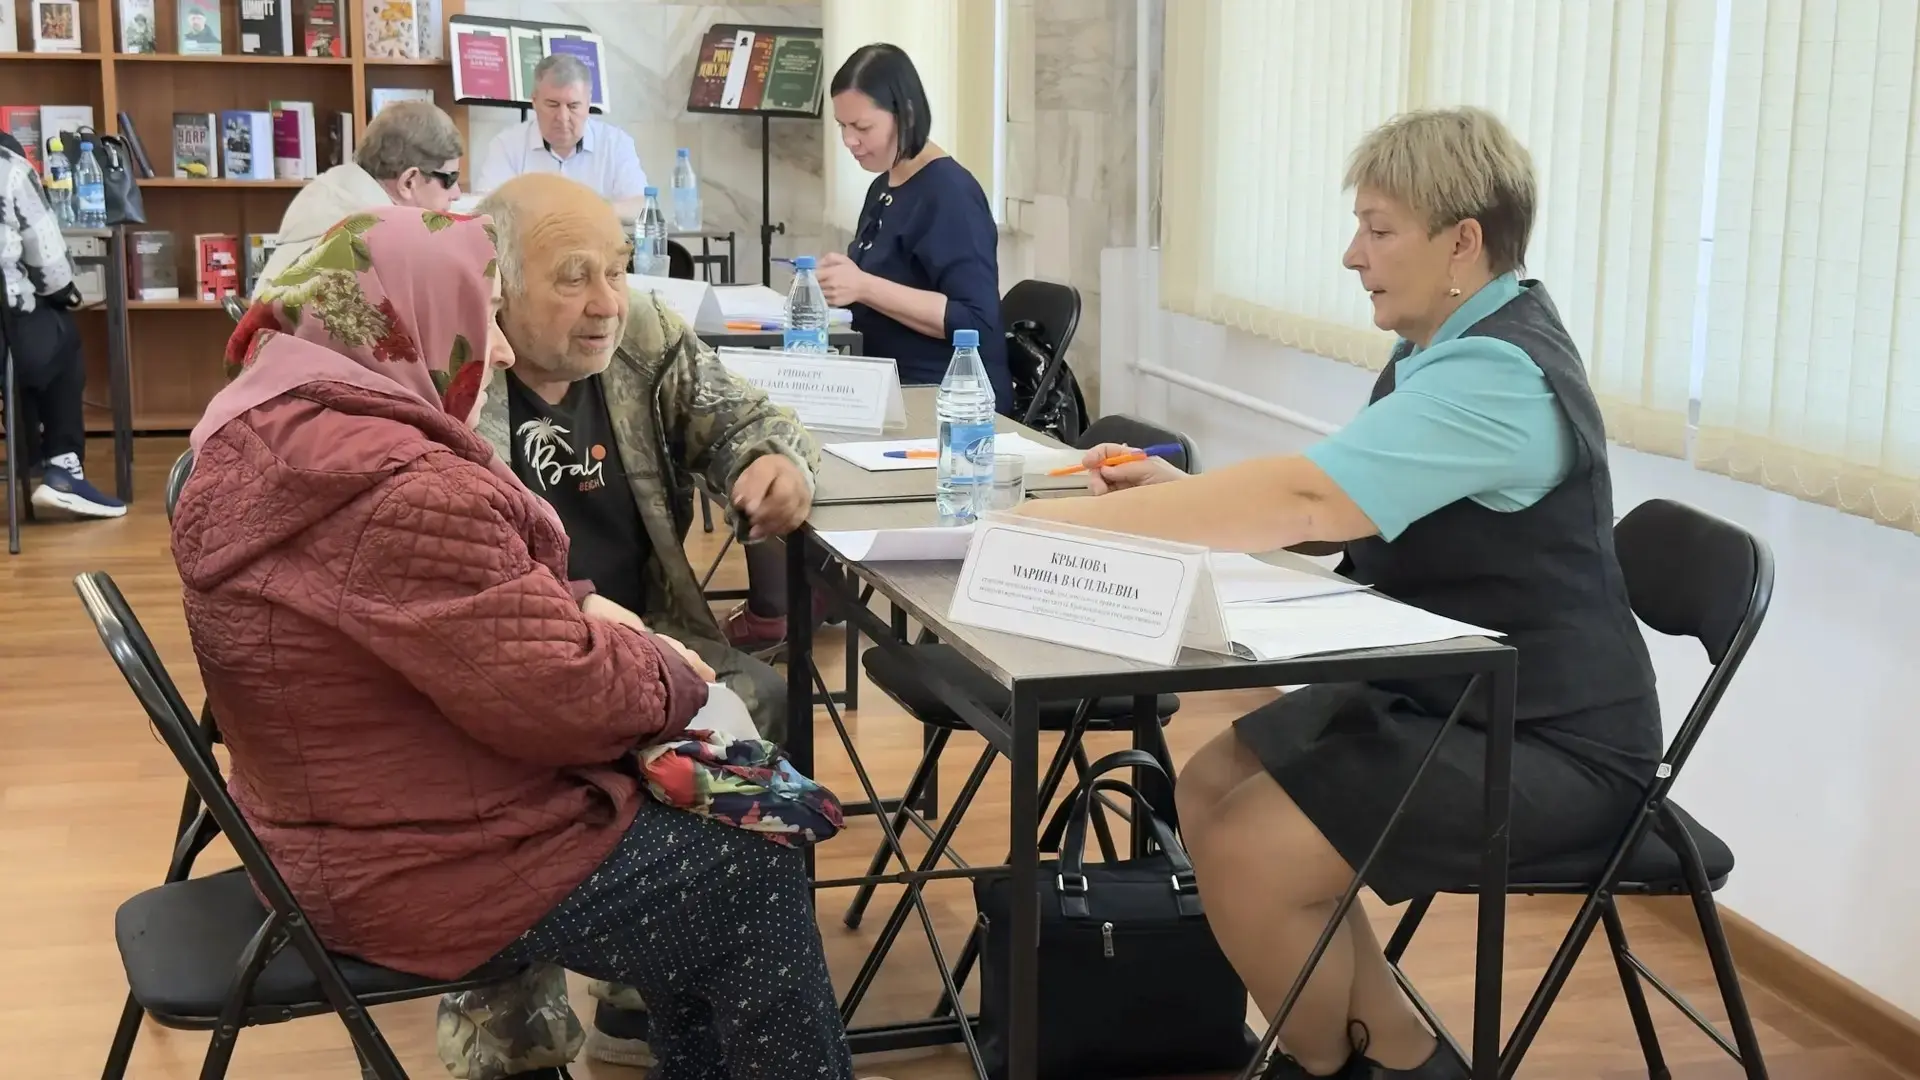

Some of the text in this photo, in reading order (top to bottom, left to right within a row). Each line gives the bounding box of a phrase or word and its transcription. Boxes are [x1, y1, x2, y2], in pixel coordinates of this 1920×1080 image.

[178, 129, 206, 144] УДАР
[531, 443, 606, 488] Bali
[1050, 551, 1108, 574] КРЫЛОВА
[1012, 564, 1060, 585] МАРИНА
[1061, 574, 1140, 600] ВАСИЛЬЕВНА
